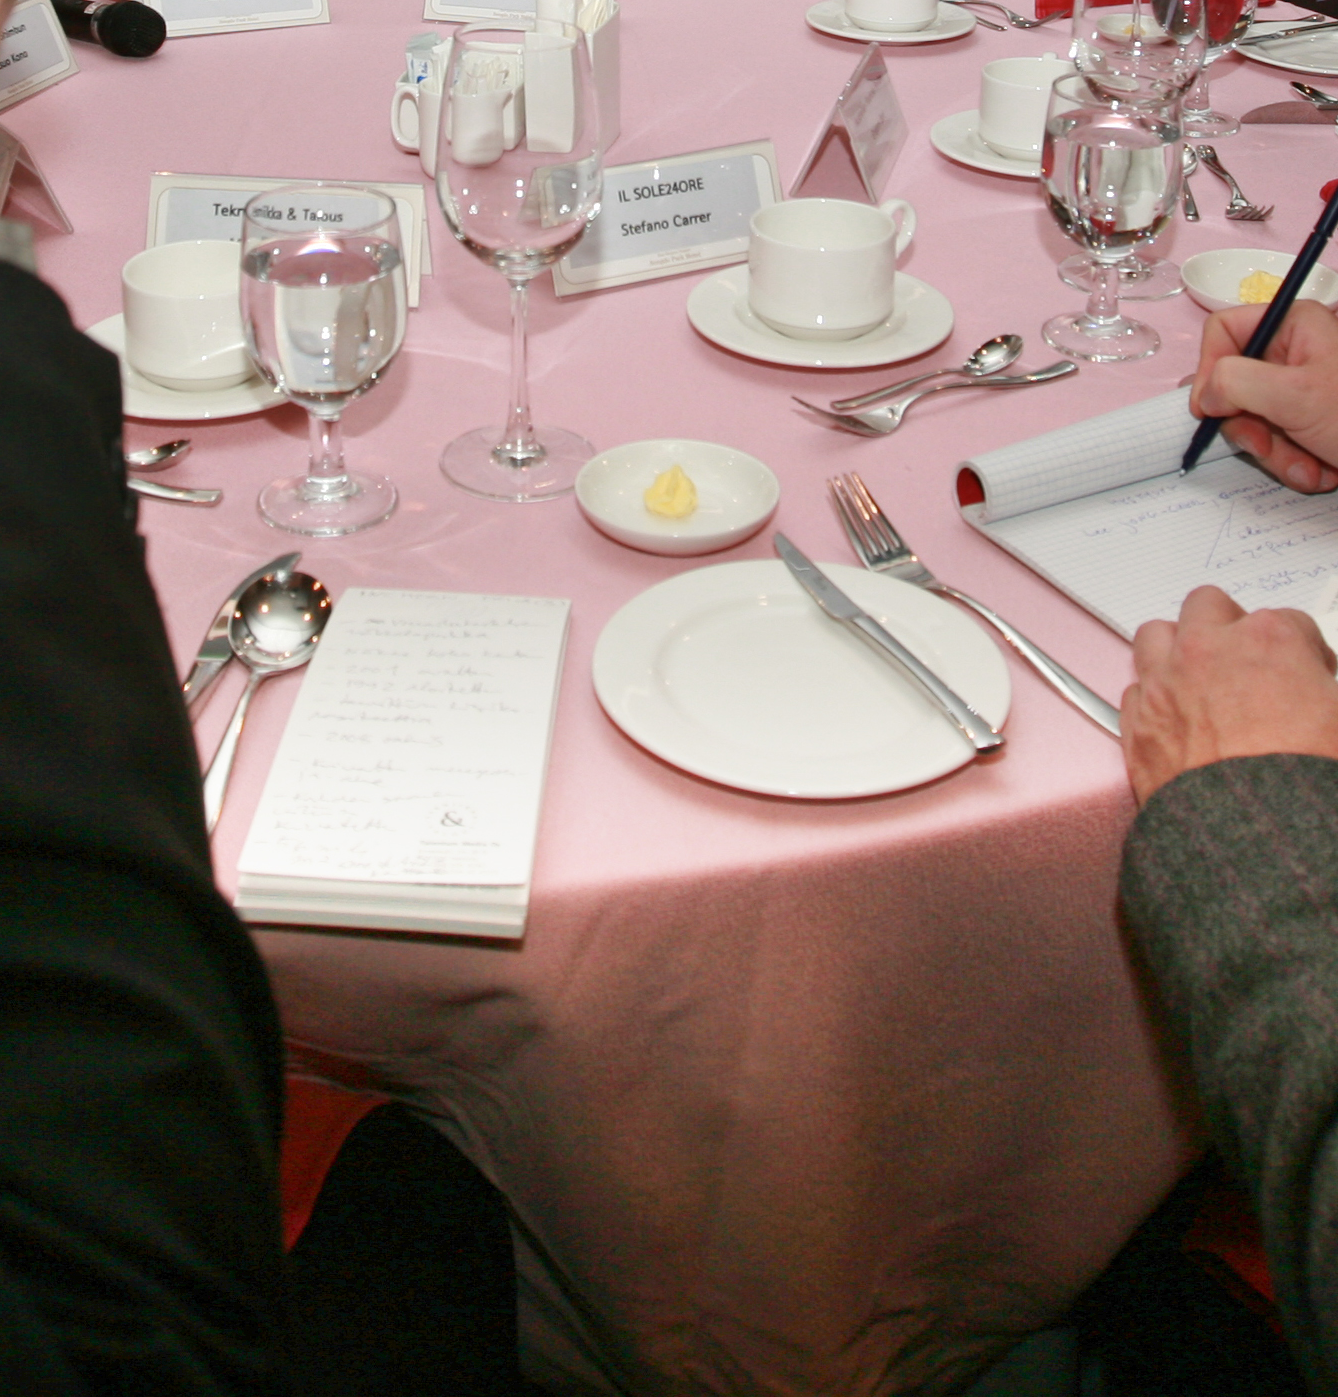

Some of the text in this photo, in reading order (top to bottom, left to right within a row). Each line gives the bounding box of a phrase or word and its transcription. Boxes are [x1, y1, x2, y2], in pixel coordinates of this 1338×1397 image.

[618, 189, 631, 203] IL
[620, 211, 712, 237] Stefano Carrer
